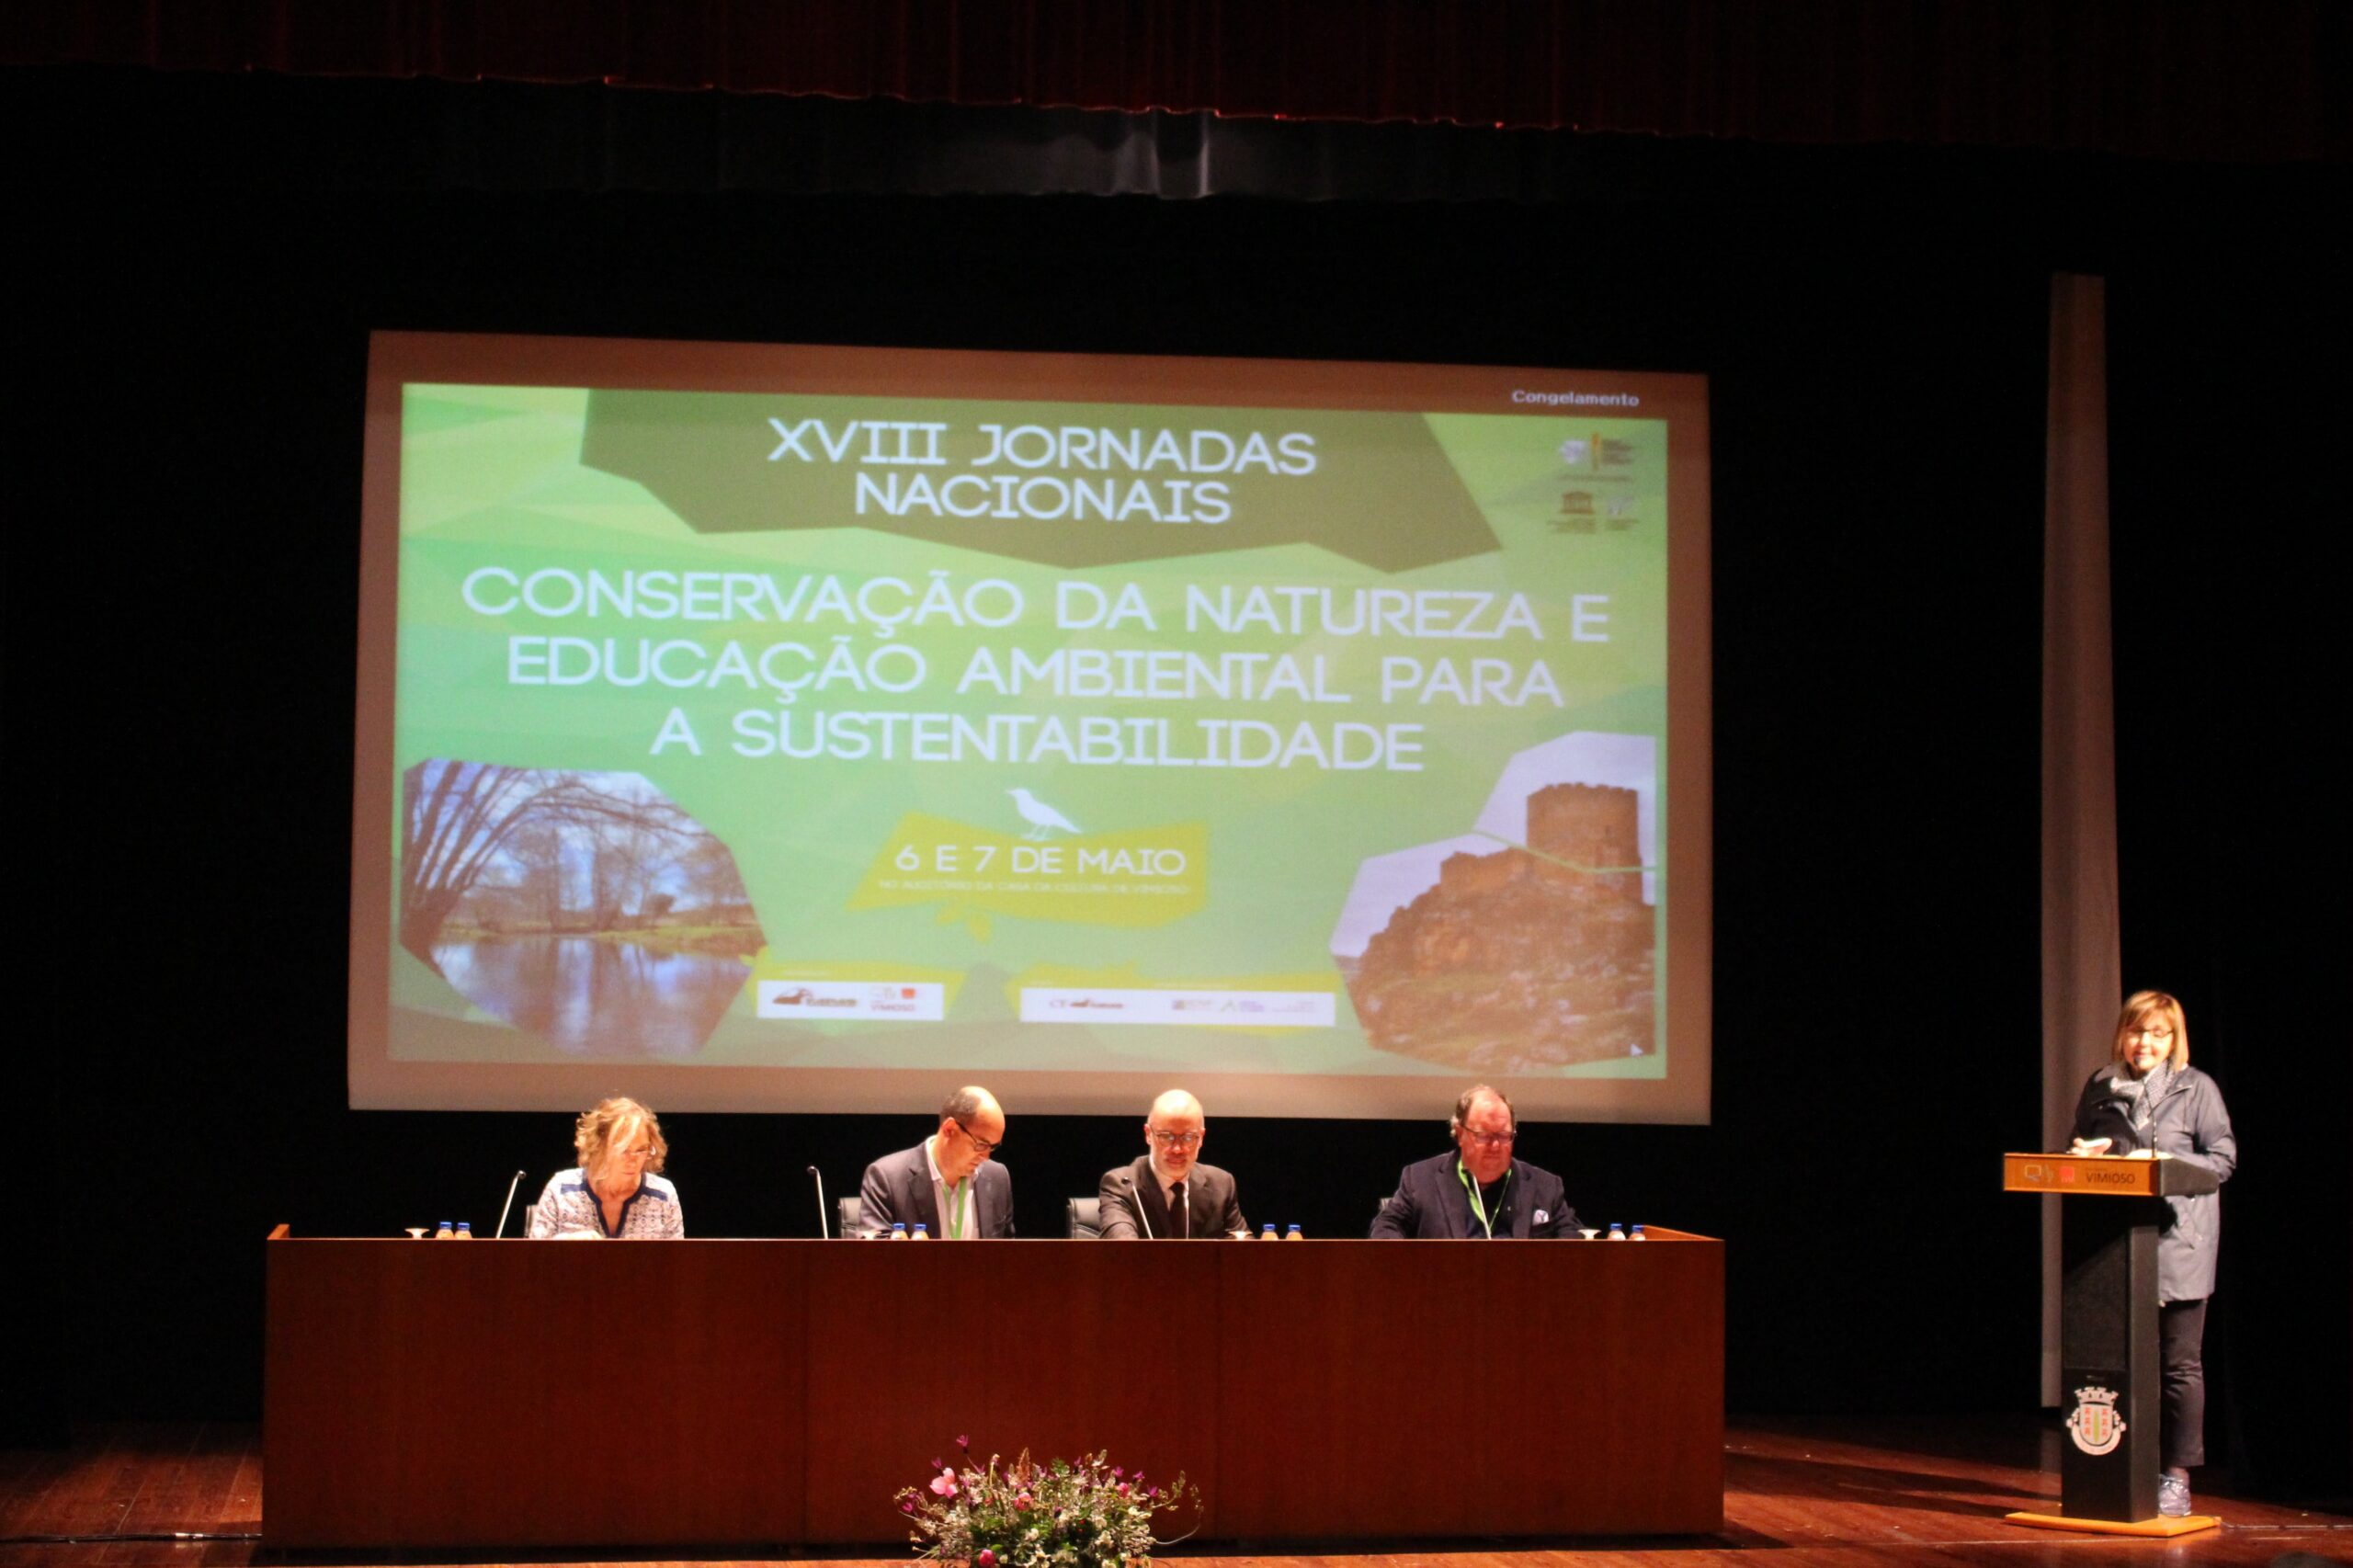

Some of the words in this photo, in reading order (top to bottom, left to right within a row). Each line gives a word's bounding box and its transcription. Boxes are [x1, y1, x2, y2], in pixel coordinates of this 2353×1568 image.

[1512, 390, 1640, 406] Congelamento
[768, 417, 948, 465] XVIII
[971, 423, 1318, 476] JORNADAS
[856, 472, 1233, 525] NACIONAIS
[462, 566, 1024, 637] CONSERVAÇÃO
[1056, 582, 1156, 632] DA
[1187, 585, 1543, 641] NATUREZA
[1572, 596, 1609, 642] E
[507, 634, 926, 704] EDUCAÇÃO
[956, 647, 1351, 704] AMBIENTAL
[1382, 658, 1563, 708] PARA
[649, 708, 701, 756] A
[732, 710, 1424, 771] SUSTENTABILIDADE
[895, 845, 919, 871] 6
[936, 846, 957, 871] E
[972, 846, 997, 872] 7
[1012, 846, 1062, 874] DE
[1077, 848, 1187, 877] MAIO
[2086, 1173, 2135, 1184] VIMIOSO
